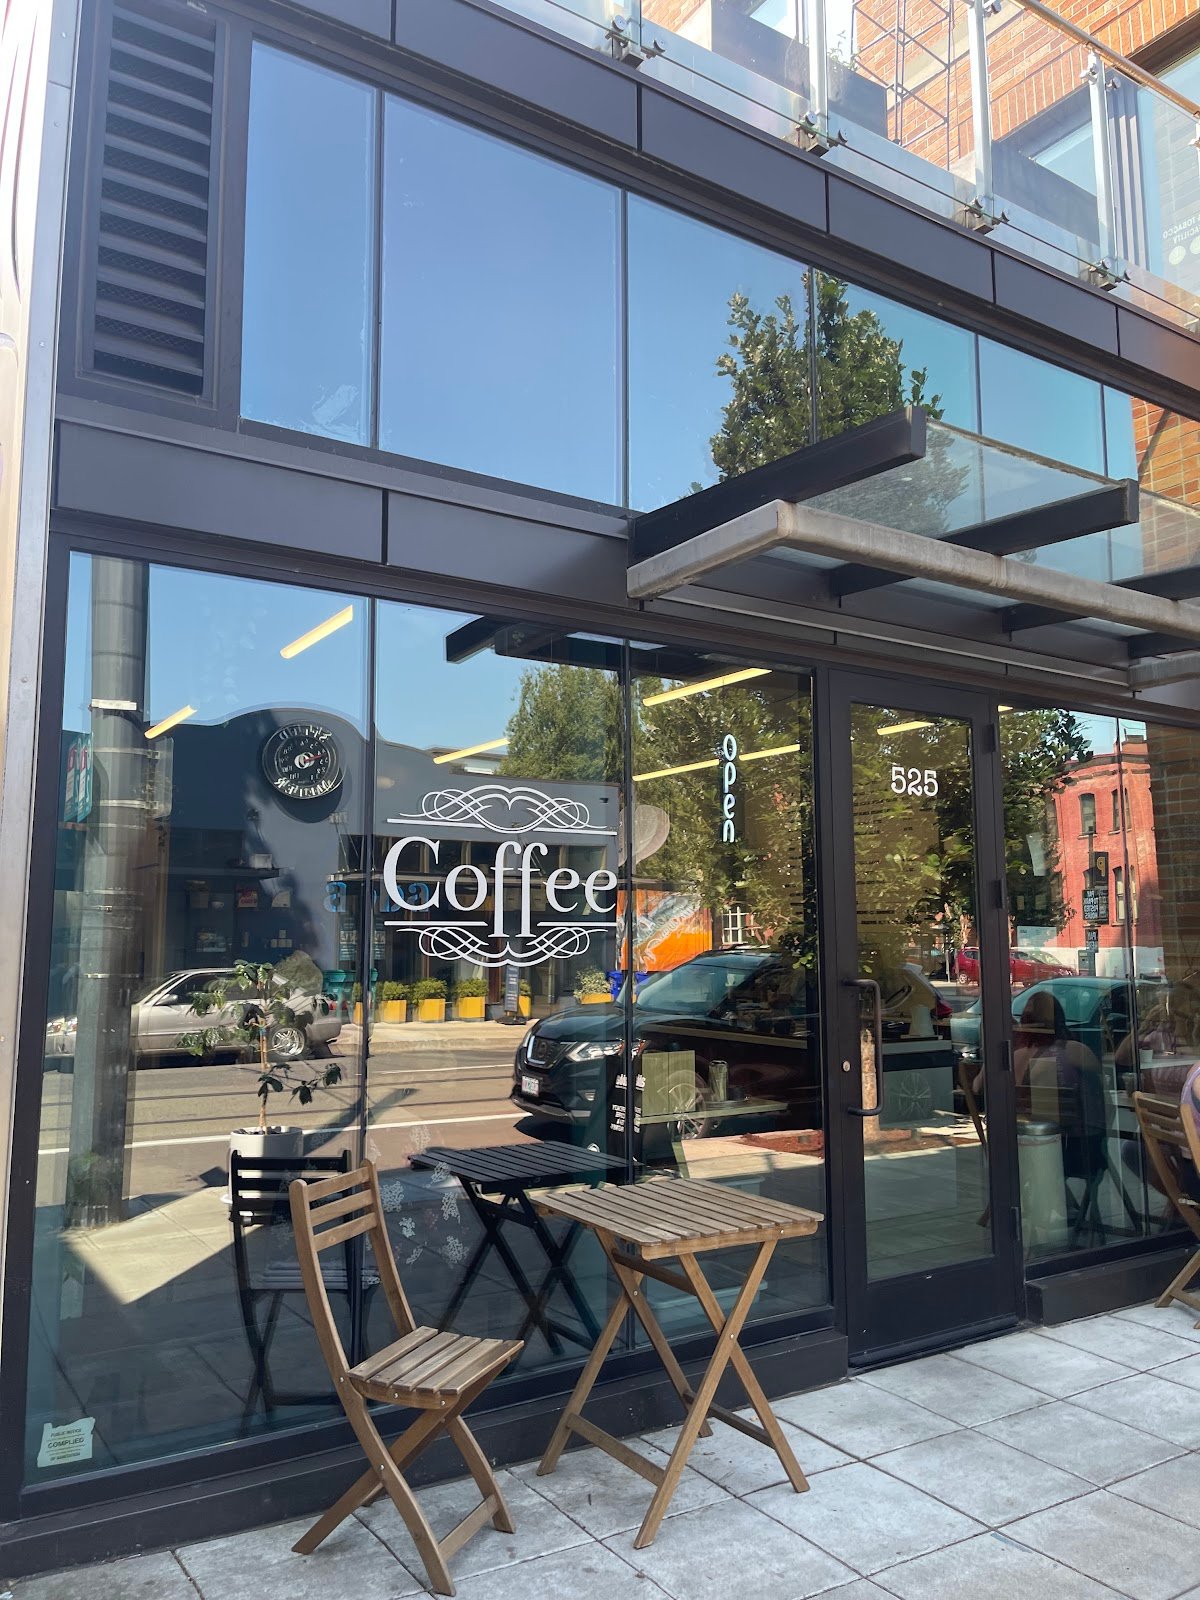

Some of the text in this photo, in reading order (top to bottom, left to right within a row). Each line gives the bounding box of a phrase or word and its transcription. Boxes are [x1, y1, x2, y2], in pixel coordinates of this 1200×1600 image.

[722, 734, 737, 843] open
[891, 766, 939, 797] 525
[383, 836, 617, 938] Coffee
[48, 1438, 84, 1448] COMPLIED
